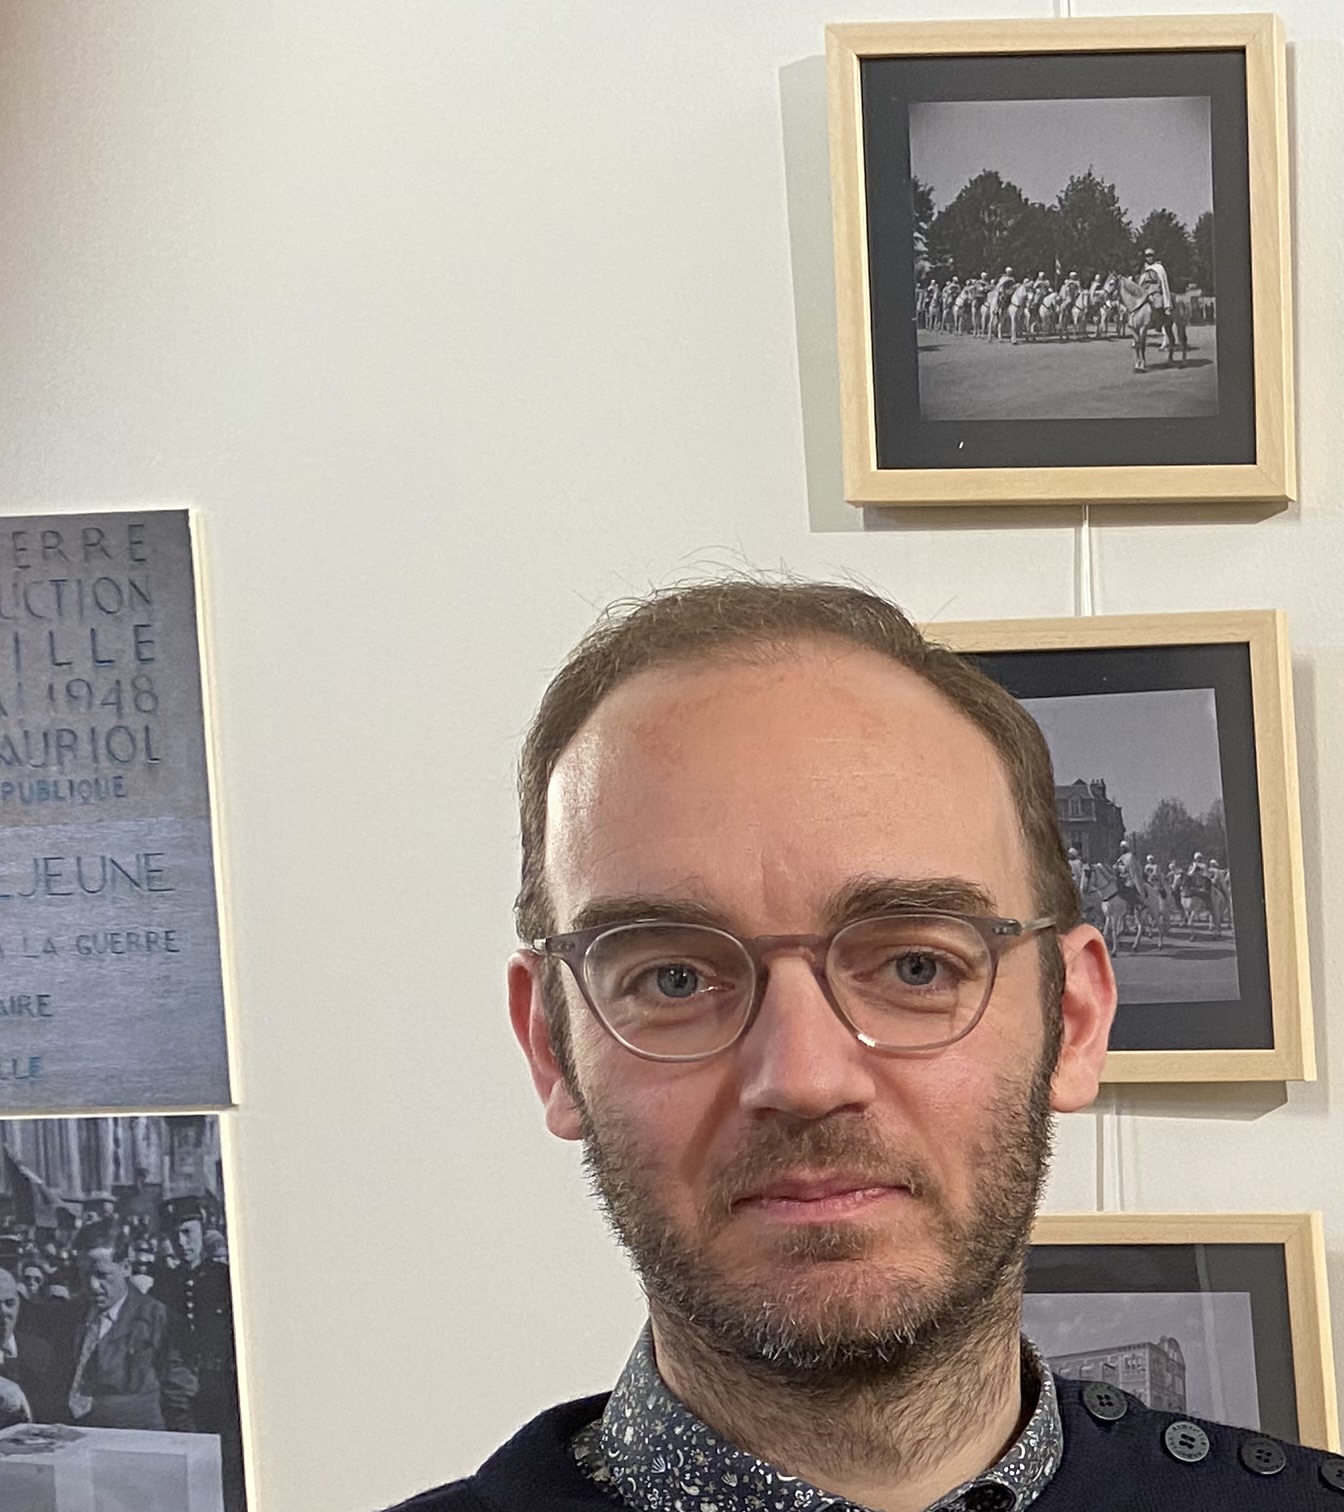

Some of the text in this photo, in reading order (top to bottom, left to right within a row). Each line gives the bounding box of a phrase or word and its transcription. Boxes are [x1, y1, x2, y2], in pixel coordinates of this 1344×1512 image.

[47, 673, 159, 719] 1948
[0, 852, 176, 899] JEUNE
[21, 929, 181, 959] LA GUERRE
